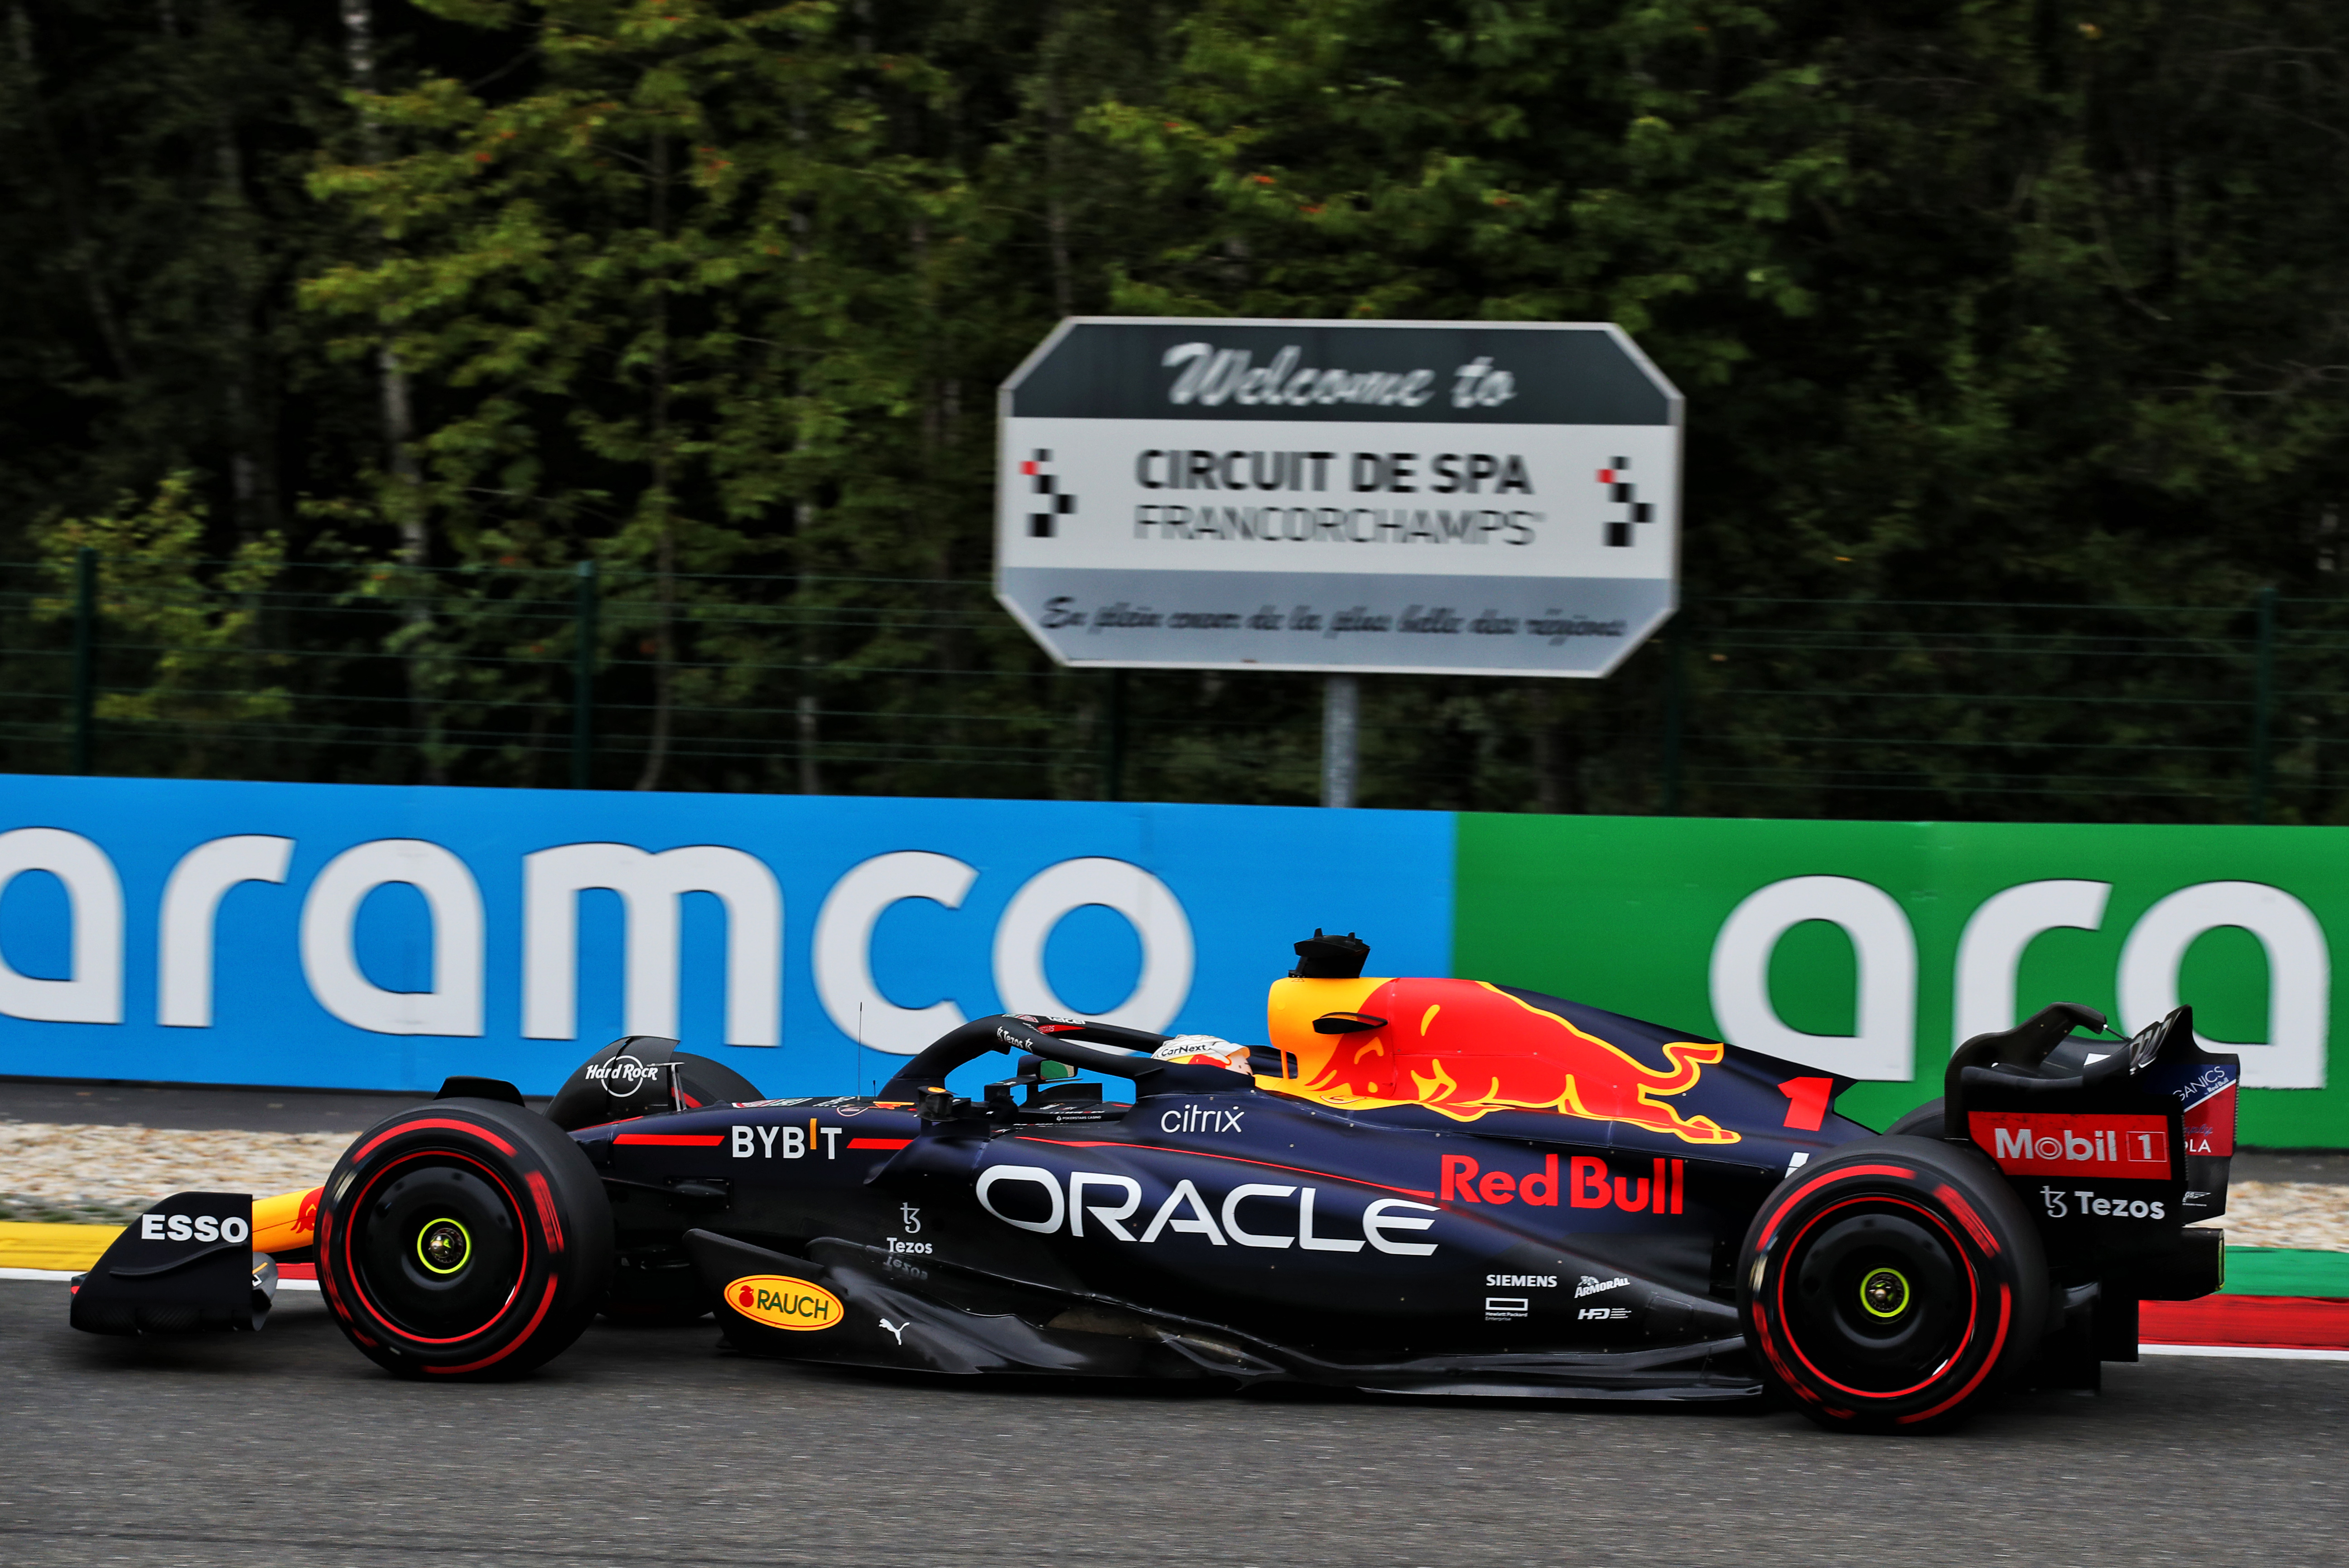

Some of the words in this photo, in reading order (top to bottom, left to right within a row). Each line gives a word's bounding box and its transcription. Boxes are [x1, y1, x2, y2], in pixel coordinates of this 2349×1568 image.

[1162, 343, 1436, 405] Welcome
[1450, 356, 1517, 408] to
[1135, 449, 1337, 491] CIRCUIT
[1351, 452, 1420, 493] DE
[1429, 453, 1535, 495] SPA
[1133, 504, 1536, 546] FRANCORCHAMPS
[1162, 1045, 1206, 1056] CarNext
[585, 1064, 622, 1079] Hard
[622, 1064, 658, 1081] Rock
[1161, 1104, 1244, 1133] citrix
[1778, 1077, 1833, 1130] 1
[732, 1118, 842, 1159] BYBIT
[1995, 1128, 2117, 1161] Mobil
[2137, 1134, 2151, 1159] 1
[1441, 1154, 1558, 1206] Red
[1571, 1156, 1683, 1214] Bull
[976, 1165, 1441, 1255] ORACLE
[2074, 1191, 2165, 1220] Tezos
[141, 1214, 248, 1243] ESSO
[887, 1237, 933, 1254] Tezos
[1486, 1274, 1558, 1287] SIEMENS
[757, 1289, 829, 1320] RAUCH
